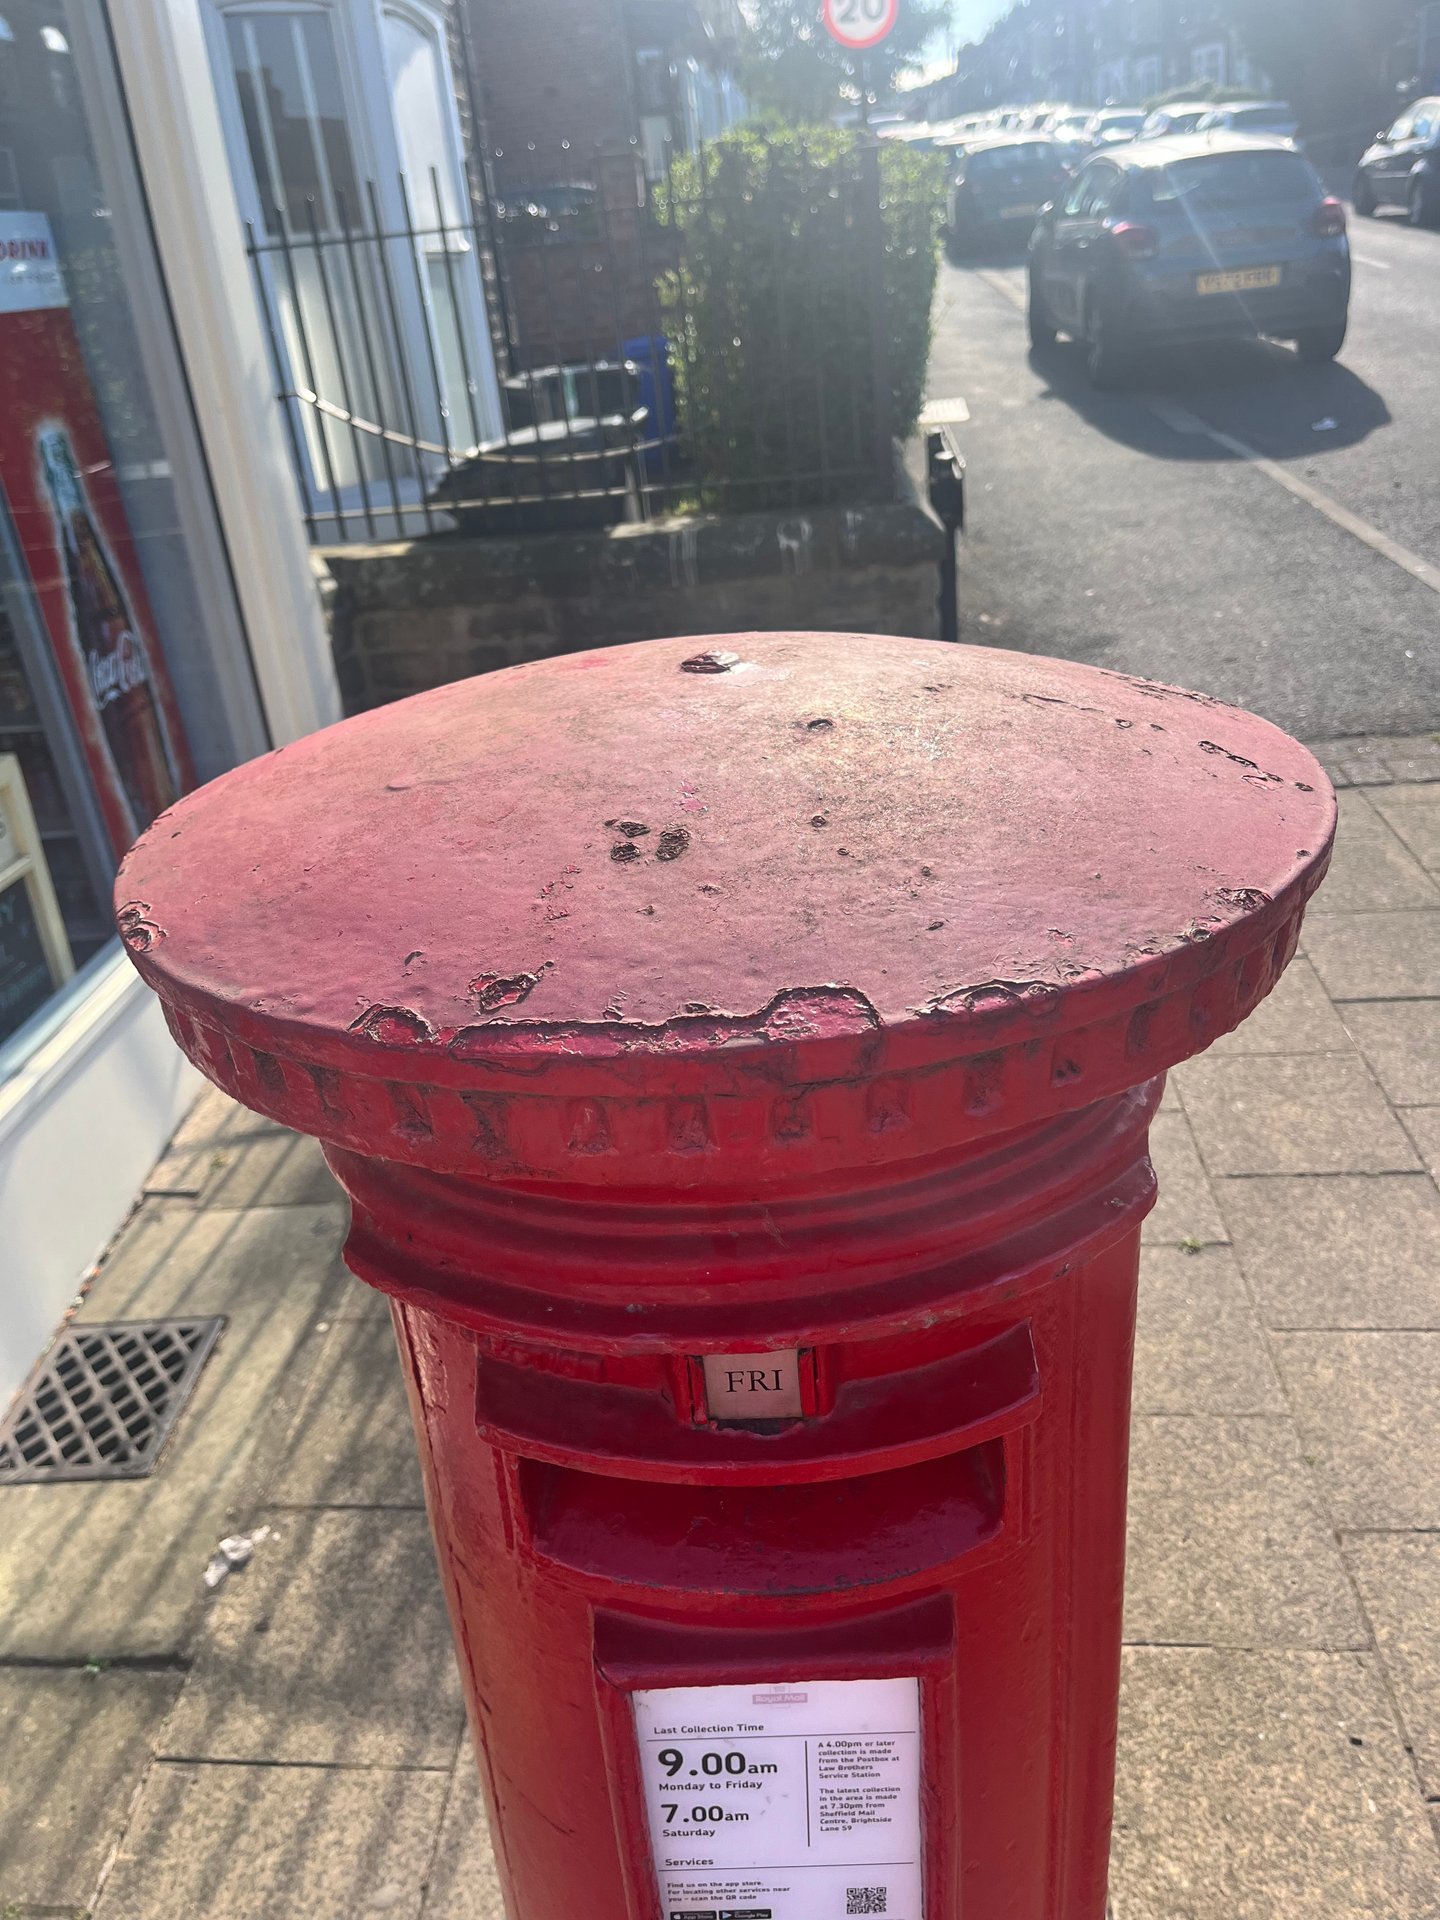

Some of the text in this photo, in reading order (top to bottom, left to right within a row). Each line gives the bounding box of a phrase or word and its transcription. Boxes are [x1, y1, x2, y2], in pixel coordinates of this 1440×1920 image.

[833, 0, 884, 24] 20
[725, 1369, 783, 1393] FRI
[755, 1693, 805, 1703] Royal Mail
[681, 1725, 734, 1733] Collection
[737, 1723, 764, 1732] Time
[658, 1748, 778, 1777] 9.00am
[659, 1782, 705, 1791] Monday
[726, 1780, 763, 1790] Friday
[661, 1804, 749, 1823] 7.00am
[662, 1828, 715, 1837] Saturday
[665, 1858, 713, 1866] Services
